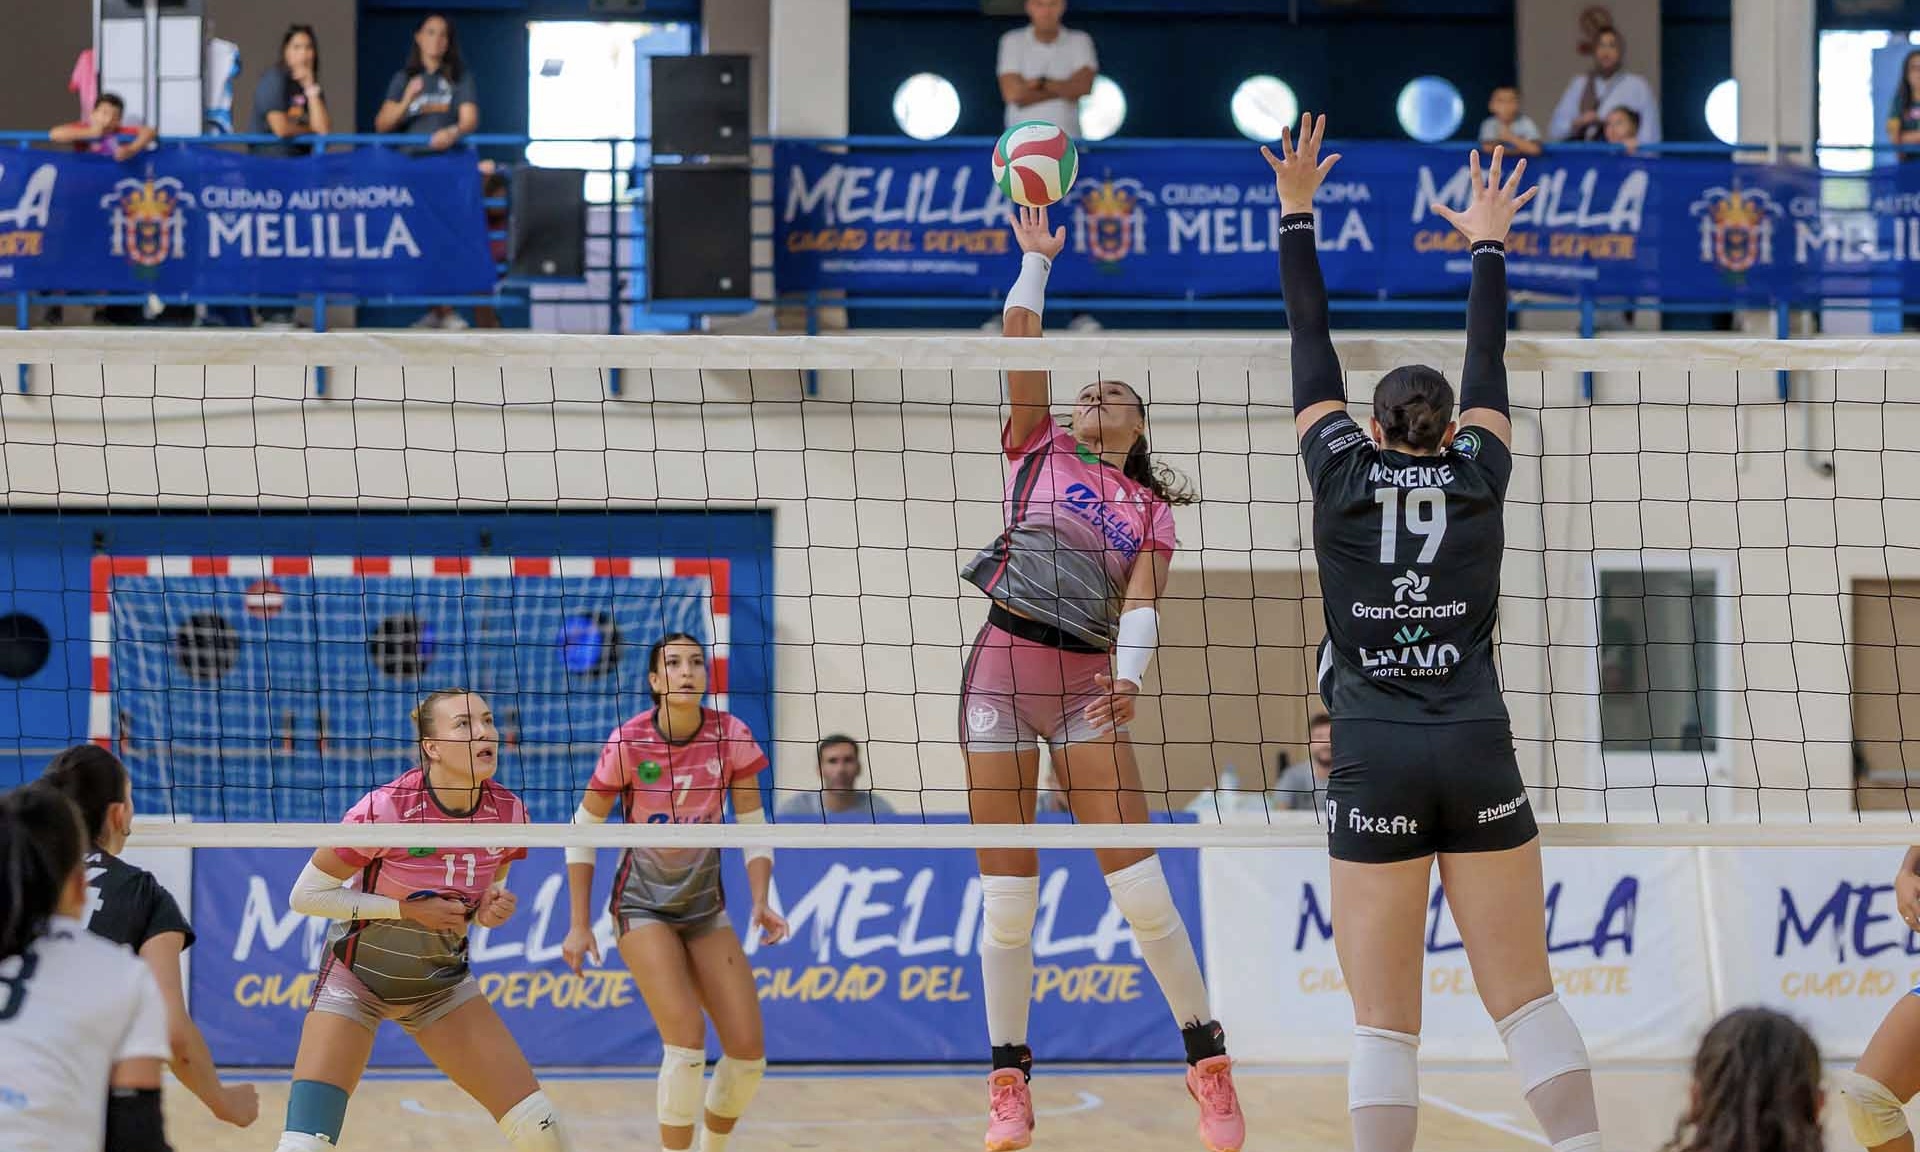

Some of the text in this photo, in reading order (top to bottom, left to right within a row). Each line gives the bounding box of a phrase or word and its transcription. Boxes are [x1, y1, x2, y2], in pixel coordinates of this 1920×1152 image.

[207, 212, 422, 258] MELILLA
[1167, 207, 1374, 253] MELILA
[1374, 486, 1448, 564] 19
[1351, 600, 1467, 620] GranCanaria
[1372, 667, 1449, 678] HOTEL GROUP
[673, 773, 693, 806] 7
[440, 853, 476, 887] 11
[743, 862, 1145, 964] MELILA
[899, 964, 971, 1002] DEL
[1032, 963, 1143, 1003] PORTE
